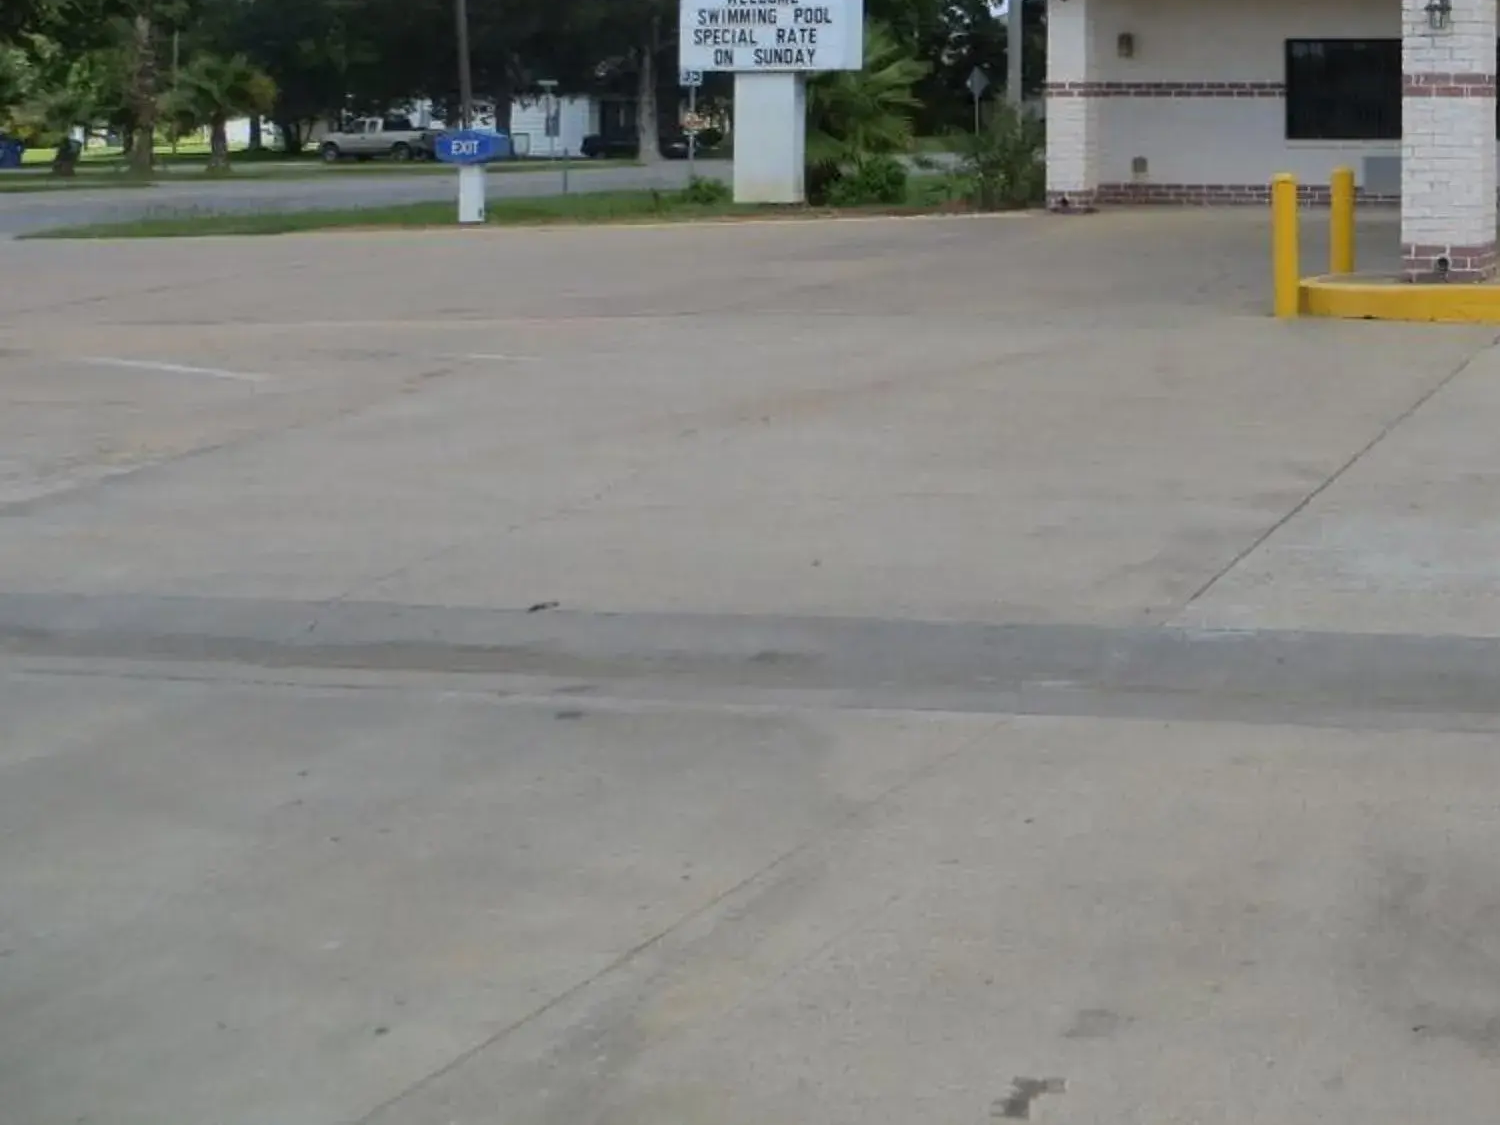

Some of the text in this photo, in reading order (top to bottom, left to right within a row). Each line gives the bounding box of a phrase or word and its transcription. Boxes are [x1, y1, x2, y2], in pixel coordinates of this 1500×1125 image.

[697, 7, 833, 25] SWIMMING POOL
[693, 27, 817, 45] SPECIAL RATE
[713, 48, 816, 66] ON SUNDAY
[451, 140, 479, 156] EXIT
